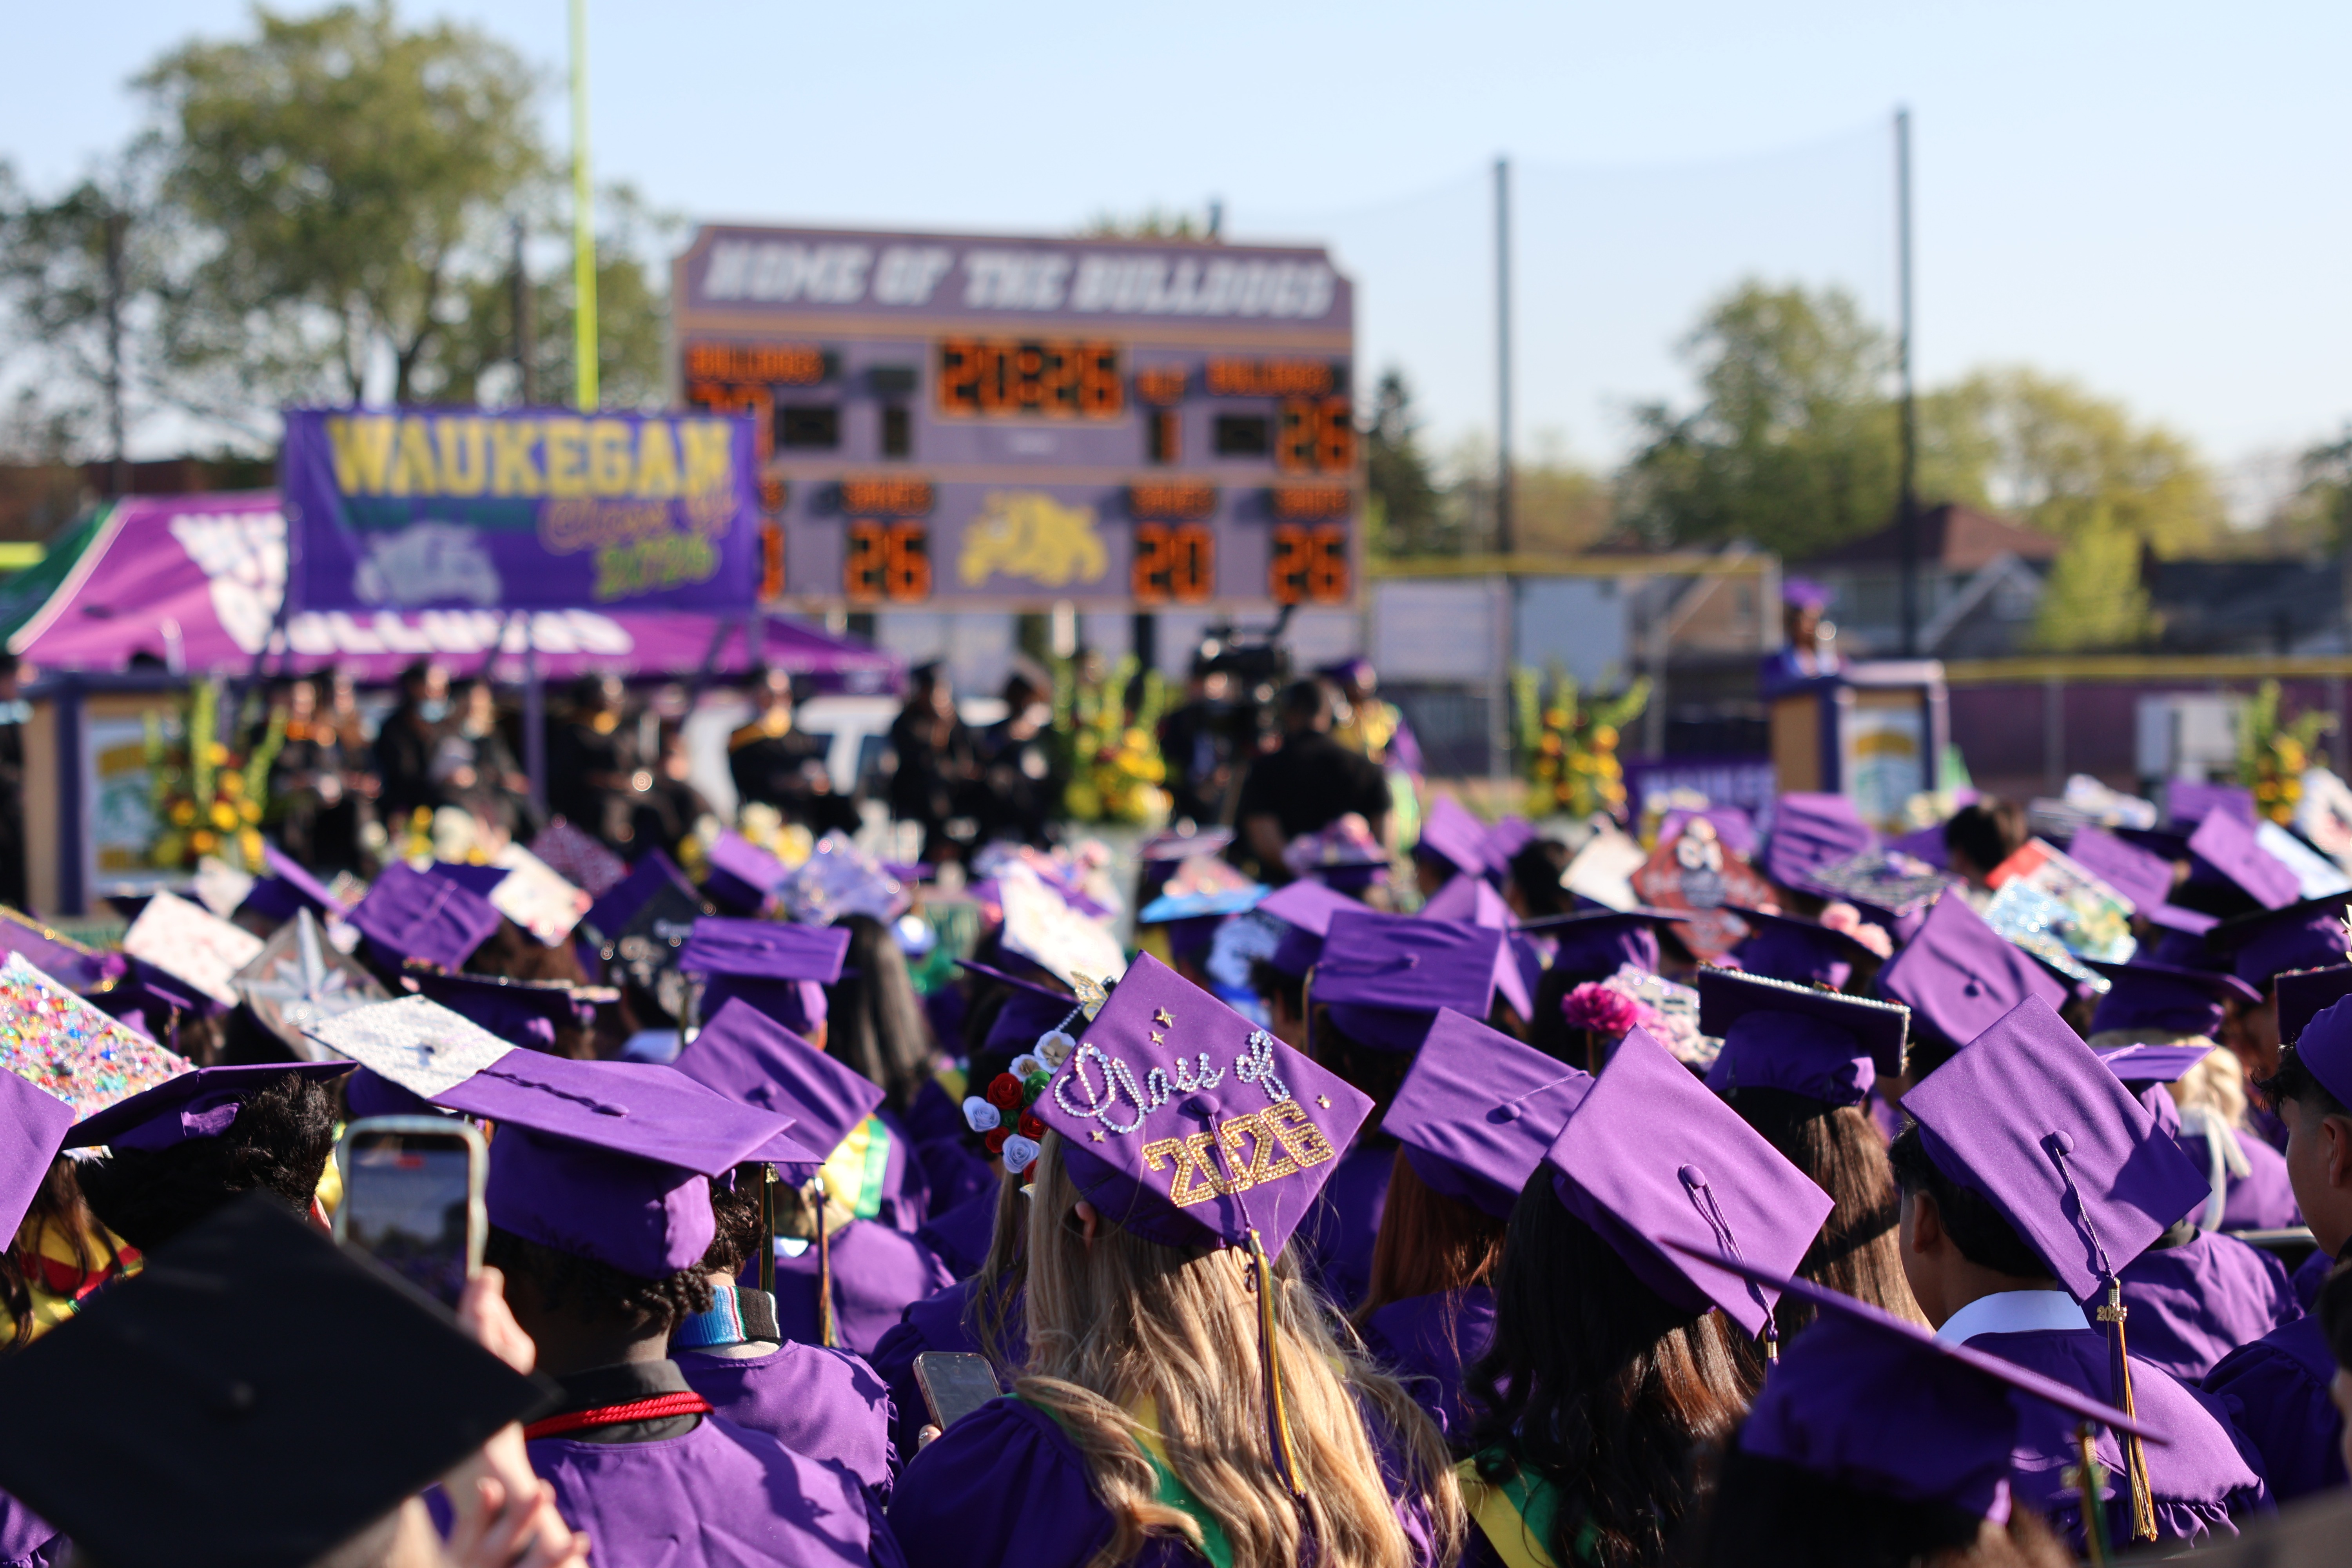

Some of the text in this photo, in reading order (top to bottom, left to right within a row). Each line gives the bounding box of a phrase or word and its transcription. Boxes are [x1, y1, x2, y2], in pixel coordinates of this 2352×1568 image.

[706, 244, 1332, 317] HOME OF THE BULLDOGS
[688, 343, 821, 382] BULLDOGS
[941, 339, 1119, 416] 20:26
[1210, 359, 1330, 394] BULLDOGS
[327, 417, 731, 496] WAUKEGAN
[1278, 399, 1354, 474] 26
[848, 524, 928, 600] 26
[1134, 527, 1213, 601] 20
[1272, 528, 1347, 601] 26
[1054, 1029, 1290, 1134] Class of
[1141, 1099, 1335, 1209] 2026
